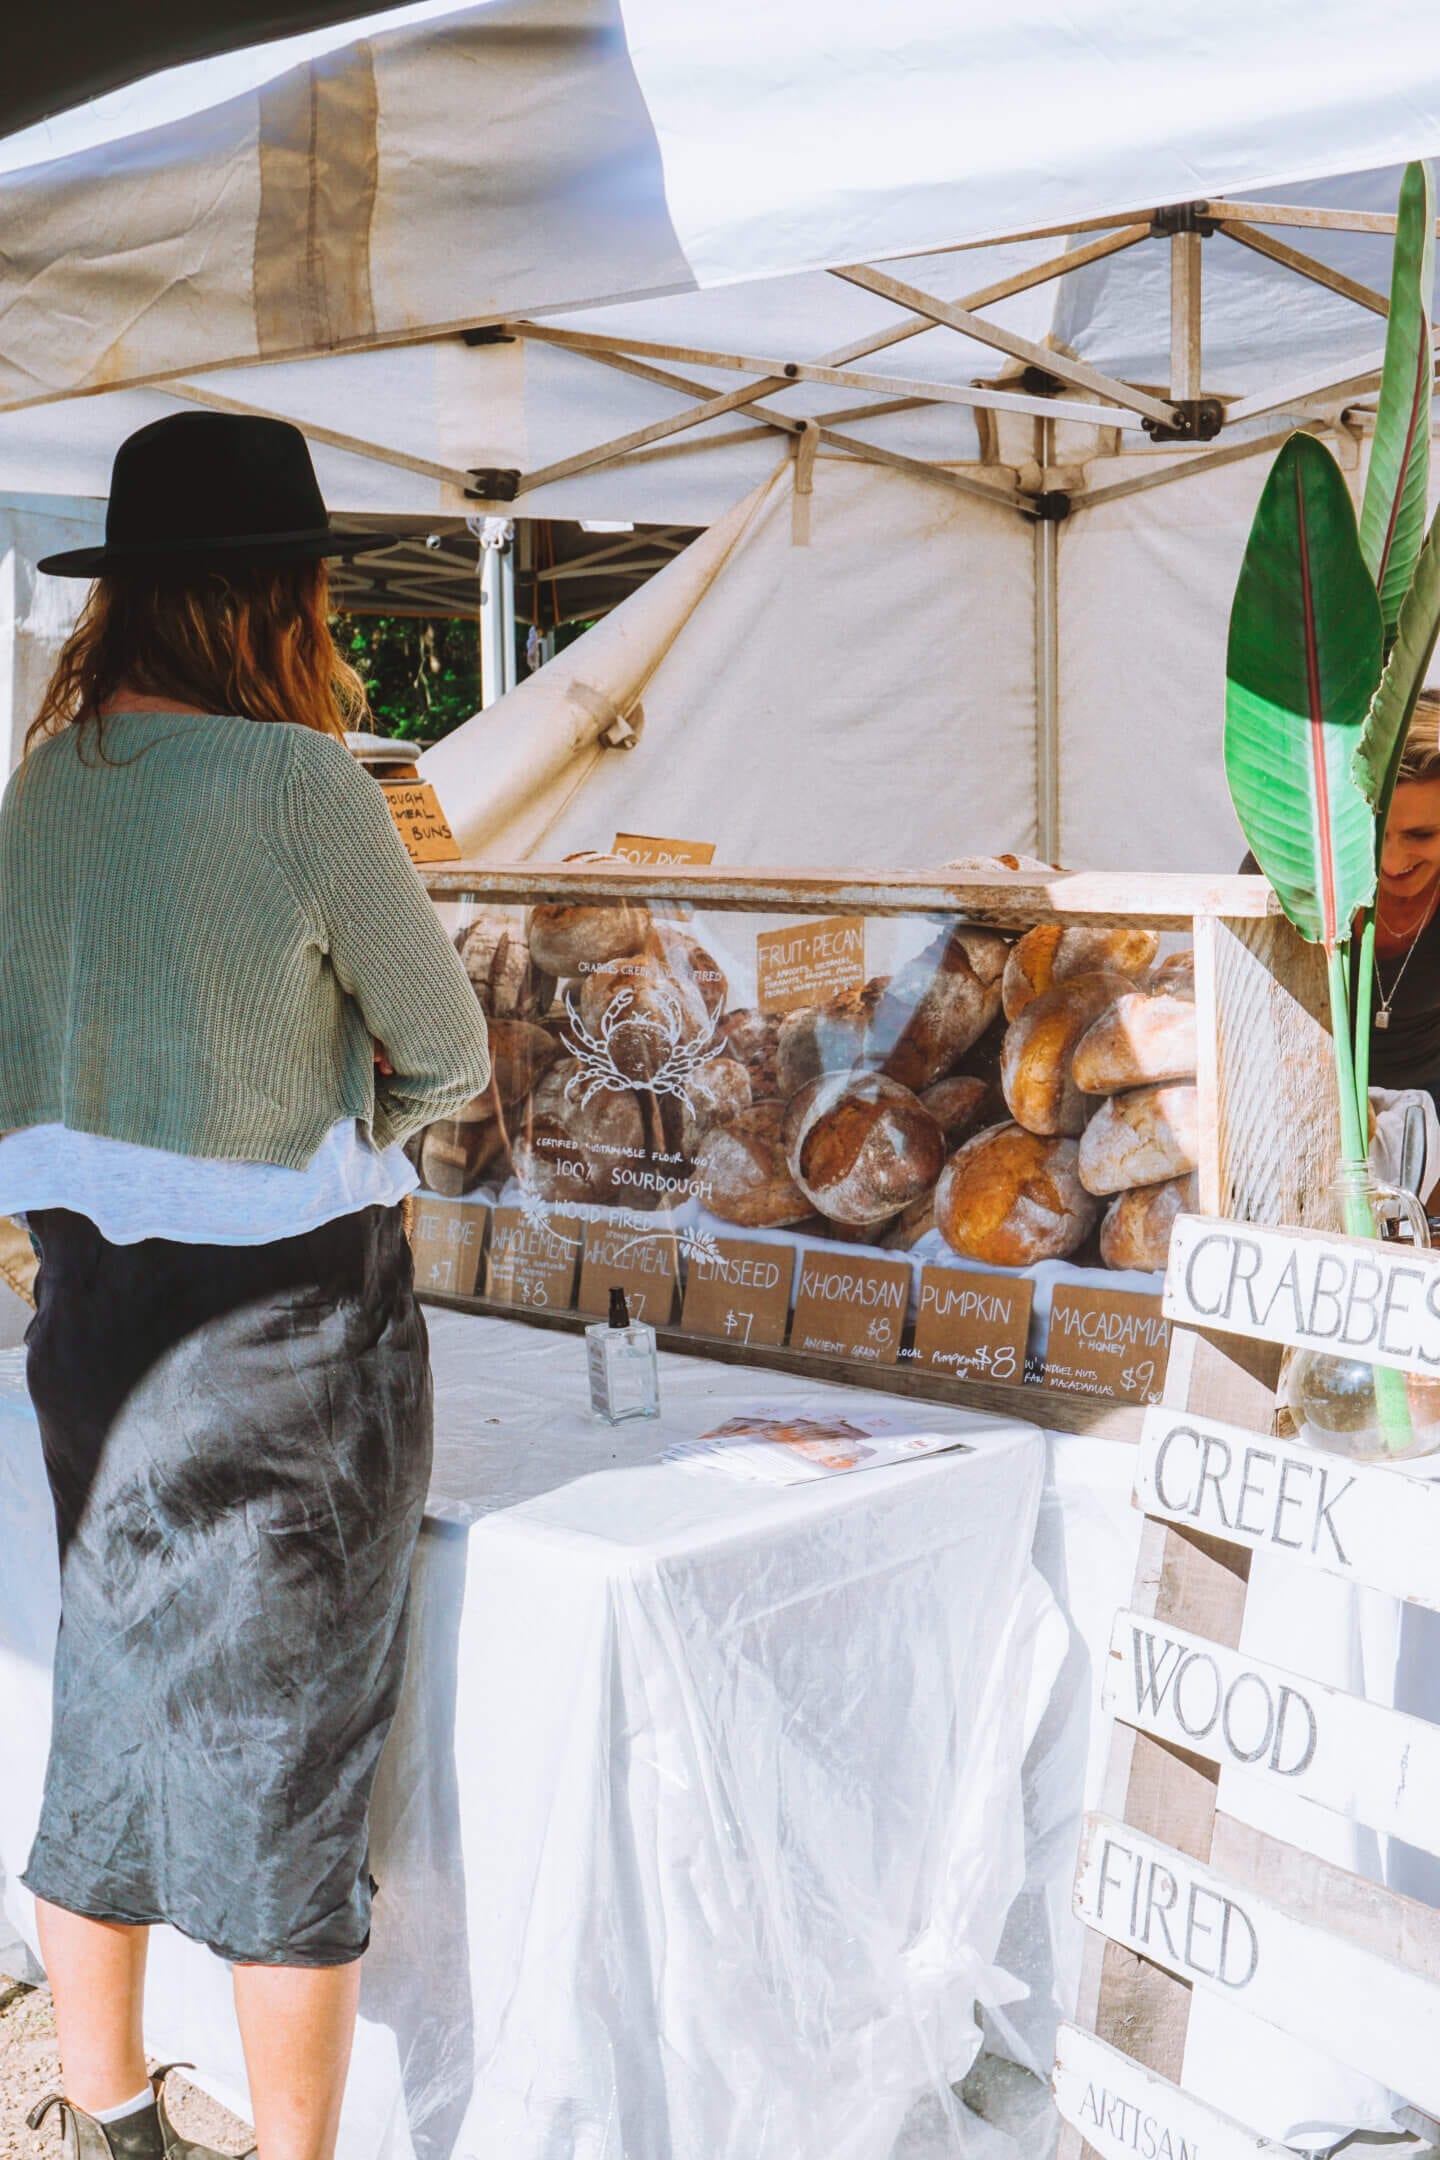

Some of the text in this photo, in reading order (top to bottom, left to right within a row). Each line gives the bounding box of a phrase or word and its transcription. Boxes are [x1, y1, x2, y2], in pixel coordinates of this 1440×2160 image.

[412, 825, 452, 841] BUNS
[692, 969, 723, 983] FIRED
[535, 1137, 579, 1150] CERTIFIED
[651, 1151, 684, 1165] FLOUR
[611, 1167, 713, 1200] SOURDOUGH
[554, 1199, 602, 1225] WOOD
[608, 1208, 653, 1232] FIRED
[490, 1224, 577, 1261] WHOLEMEAL
[583, 1239, 672, 1276] WHOLEMEAL
[429, 1261, 453, 1289] $7
[698, 1259, 780, 1289] LINSEED
[800, 1270, 904, 1309] KHORASAN
[521, 1280, 548, 1307] $8
[920, 1285, 1012, 1325] PUMPKIN
[724, 1309, 755, 1345] $7
[1050, 1306, 1170, 1349] MACADAMIA
[803, 1336, 846, 1353] ANCIENT
[896, 1347, 924, 1359] LOCAL
[1088, 1340, 1127, 1358] HONEY
[975, 1344, 1016, 1379] $8
[1024, 1371, 1045, 1384] RAW
[1075, 1368, 1098, 1380] NUTS
[1119, 1360, 1155, 1402] $9
[1154, 1425, 1358, 1566] CREEK
[1131, 1623, 1317, 1777] WOOD
[1096, 1839, 1260, 1989] FIRED
